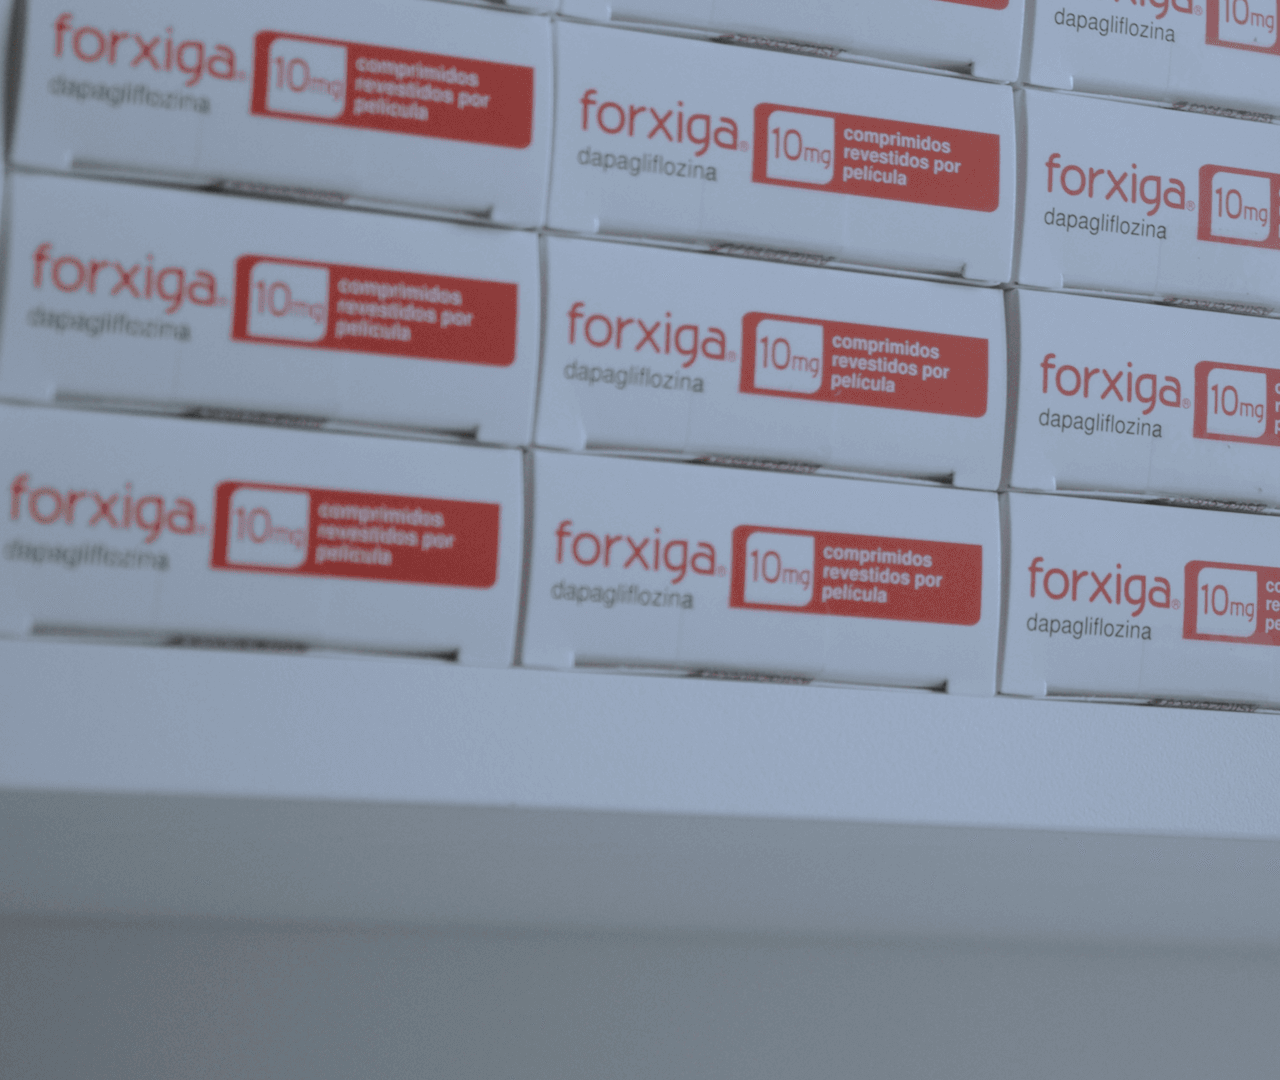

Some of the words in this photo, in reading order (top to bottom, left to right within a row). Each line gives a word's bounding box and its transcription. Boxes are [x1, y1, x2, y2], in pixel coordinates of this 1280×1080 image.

[1054, 6, 1177, 42] dapagliflozina
[772, 126, 832, 170] 10mg
[1043, 206, 1167, 240] dapagliflozina
[1215, 186, 1269, 227] 10mg
[760, 335, 820, 378] 10mg
[832, 335, 940, 359] comprimidos
[565, 359, 705, 393] dapagliflozina
[830, 371, 896, 392] película
[831, 354, 918, 376] revestidos
[921, 363, 950, 380] por
[1211, 383, 1265, 423] 10mg
[1039, 407, 1163, 438] dapagliflozina
[750, 548, 811, 591] 10mg
[552, 578, 694, 609] dapagliflozina
[1201, 582, 1256, 622] 10mg
[1026, 612, 1152, 640] dapagliflozina
